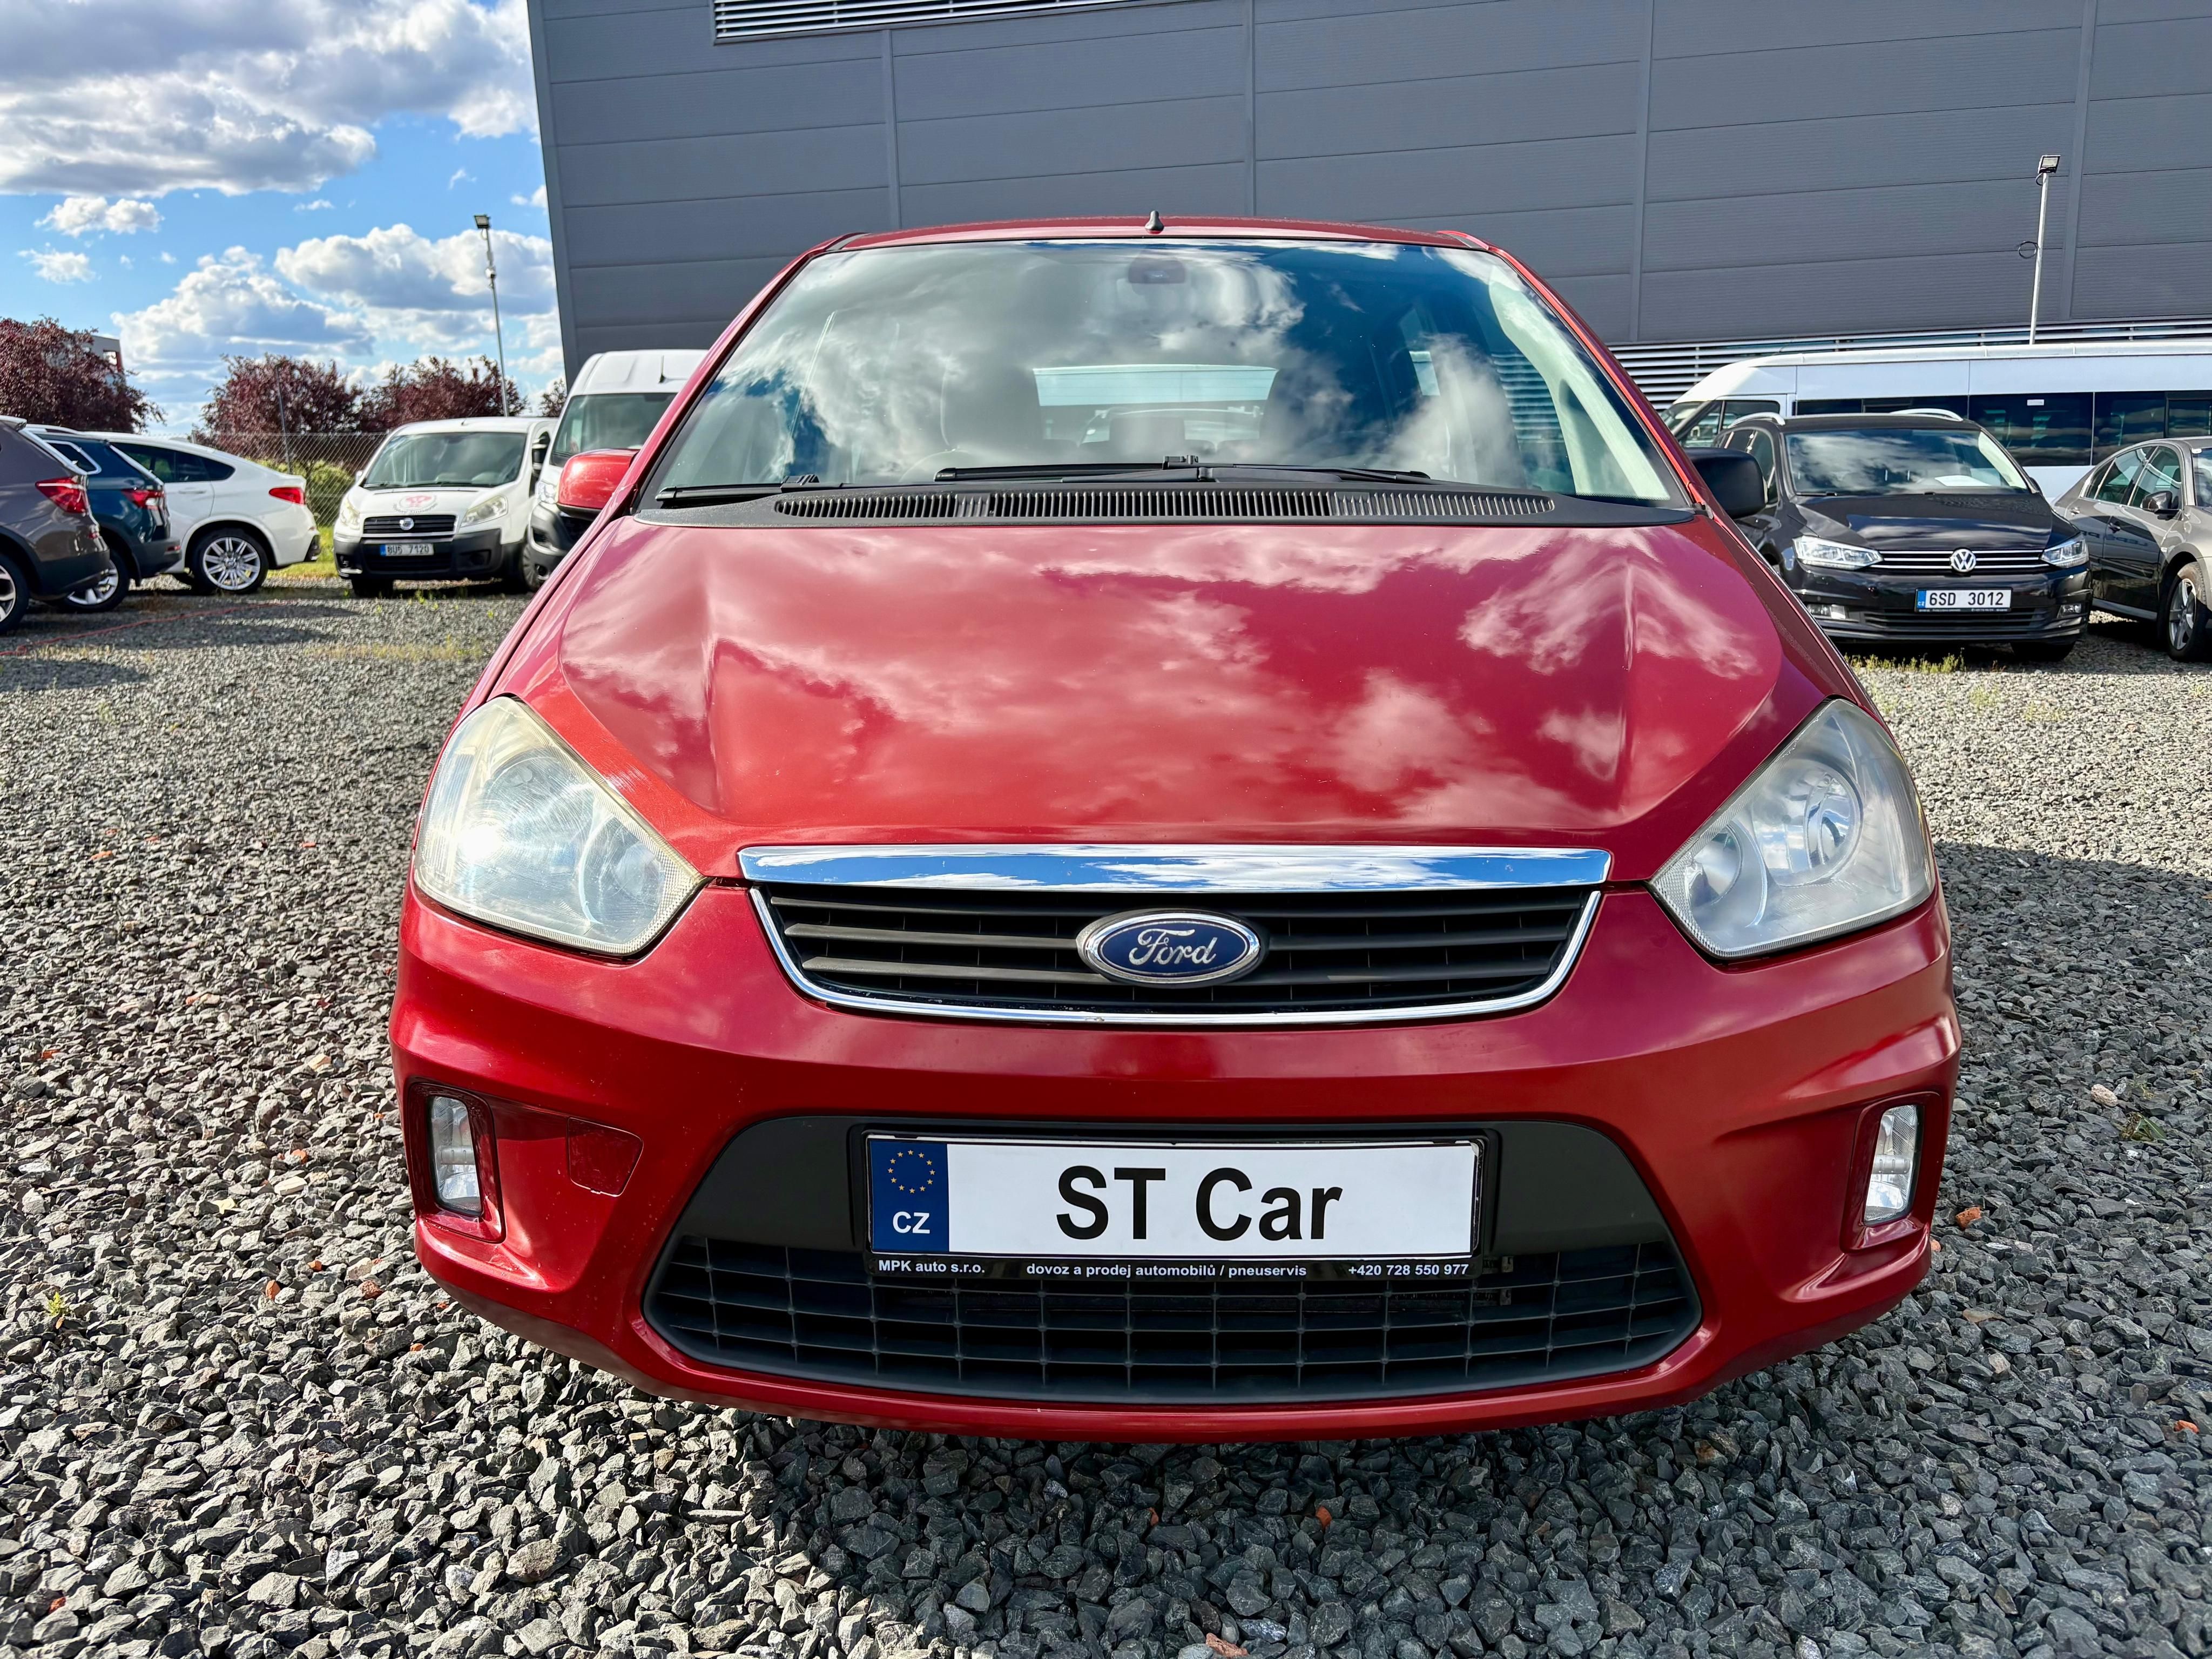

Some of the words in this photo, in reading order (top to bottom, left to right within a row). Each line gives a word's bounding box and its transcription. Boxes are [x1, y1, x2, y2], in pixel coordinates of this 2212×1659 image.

[1930, 592, 1956, 606] 6SD
[1968, 592, 2004, 605] 3012
[1129, 928, 1218, 965] Ford
[1056, 1165, 1166, 1240] ST
[1196, 1167, 1343, 1241] Car
[893, 1211, 930, 1234] CZ
[879, 1259, 912, 1271] MPK
[915, 1261, 947, 1272] auto
[950, 1264, 985, 1273] s.r.o.
[1027, 1263, 1070, 1274] dovoz
[1074, 1266, 1082, 1275] a
[1086, 1264, 1131, 1278] prodej
[1135, 1264, 1216, 1276] automobilů
[1229, 1265, 1307, 1278] pneuservis
[1348, 1265, 1382, 1276] +420
[1386, 1264, 1411, 1276] 728
[1415, 1264, 1440, 1275] 550
[1444, 1264, 1469, 1275] 977
